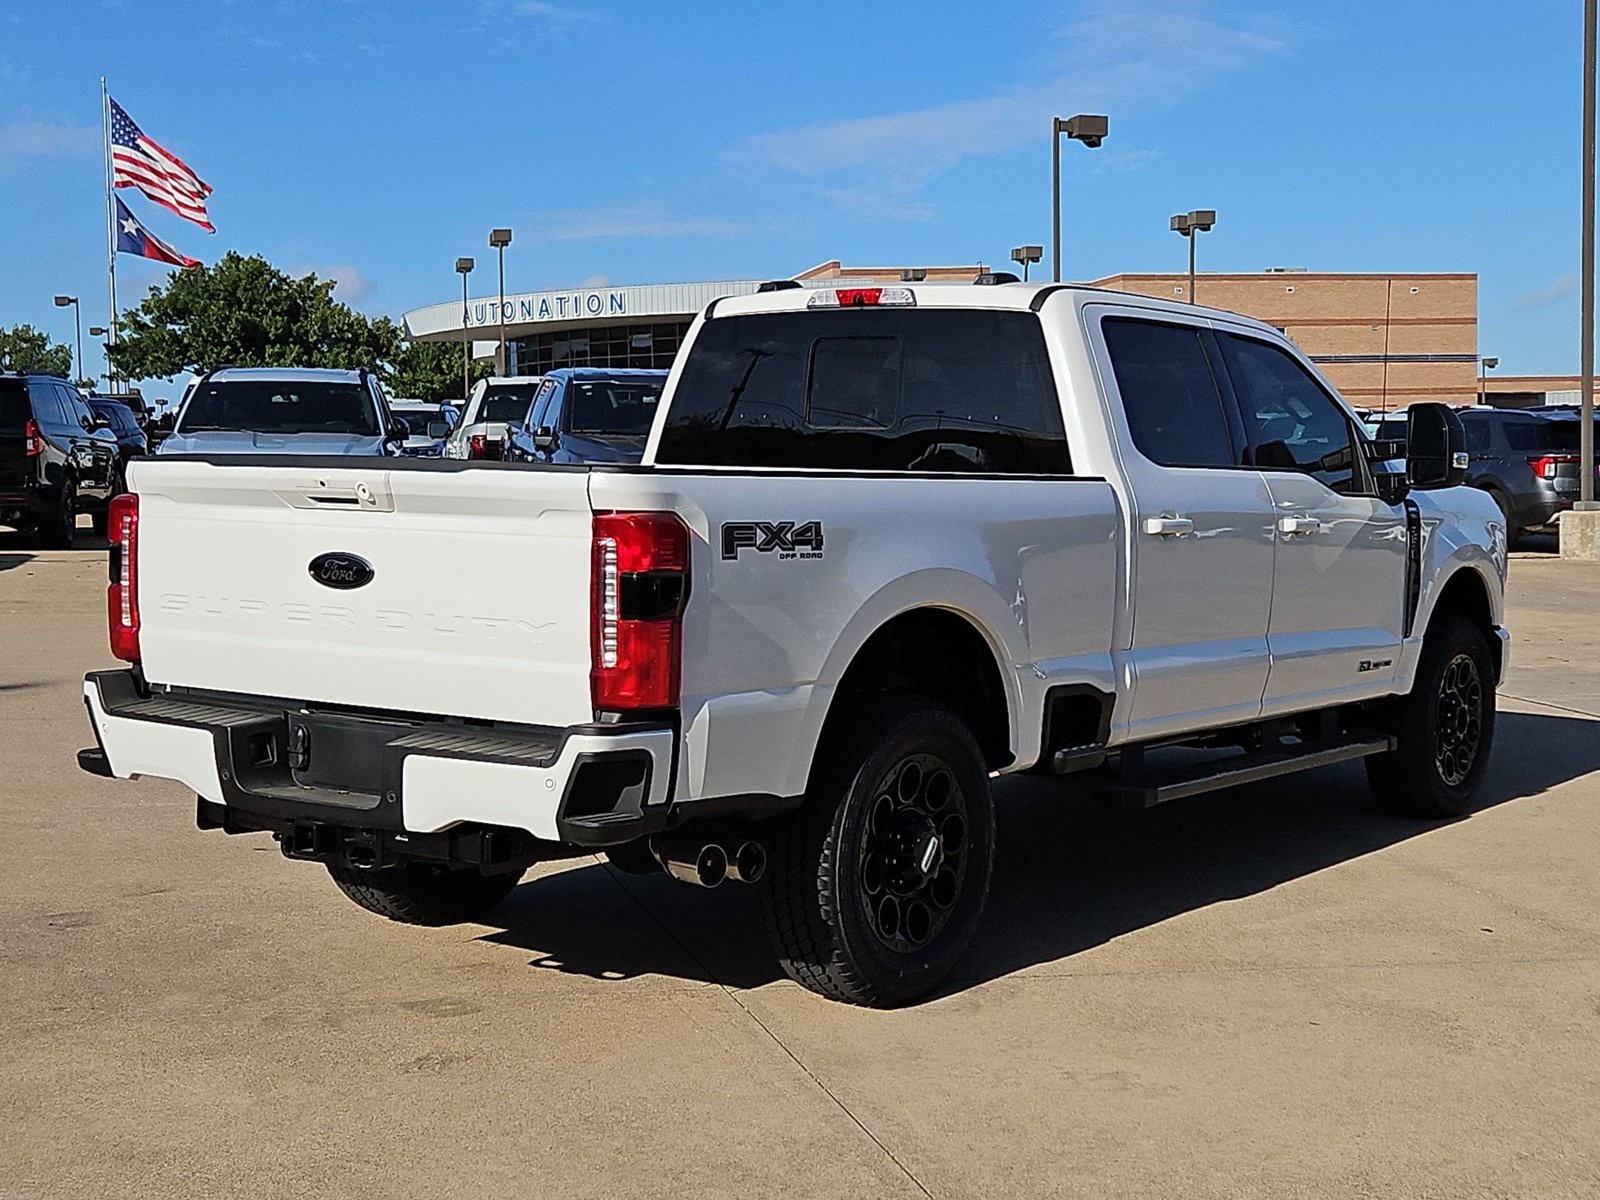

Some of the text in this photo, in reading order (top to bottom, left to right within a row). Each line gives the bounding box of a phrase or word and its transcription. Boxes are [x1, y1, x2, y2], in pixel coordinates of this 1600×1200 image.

[463, 292, 627, 325] AUTONATION
[721, 521, 823, 560] FX4
[779, 552, 823, 560] OFF ROAD
[321, 559, 358, 581] Ford
[160, 593, 558, 644] SUPER DUTY
